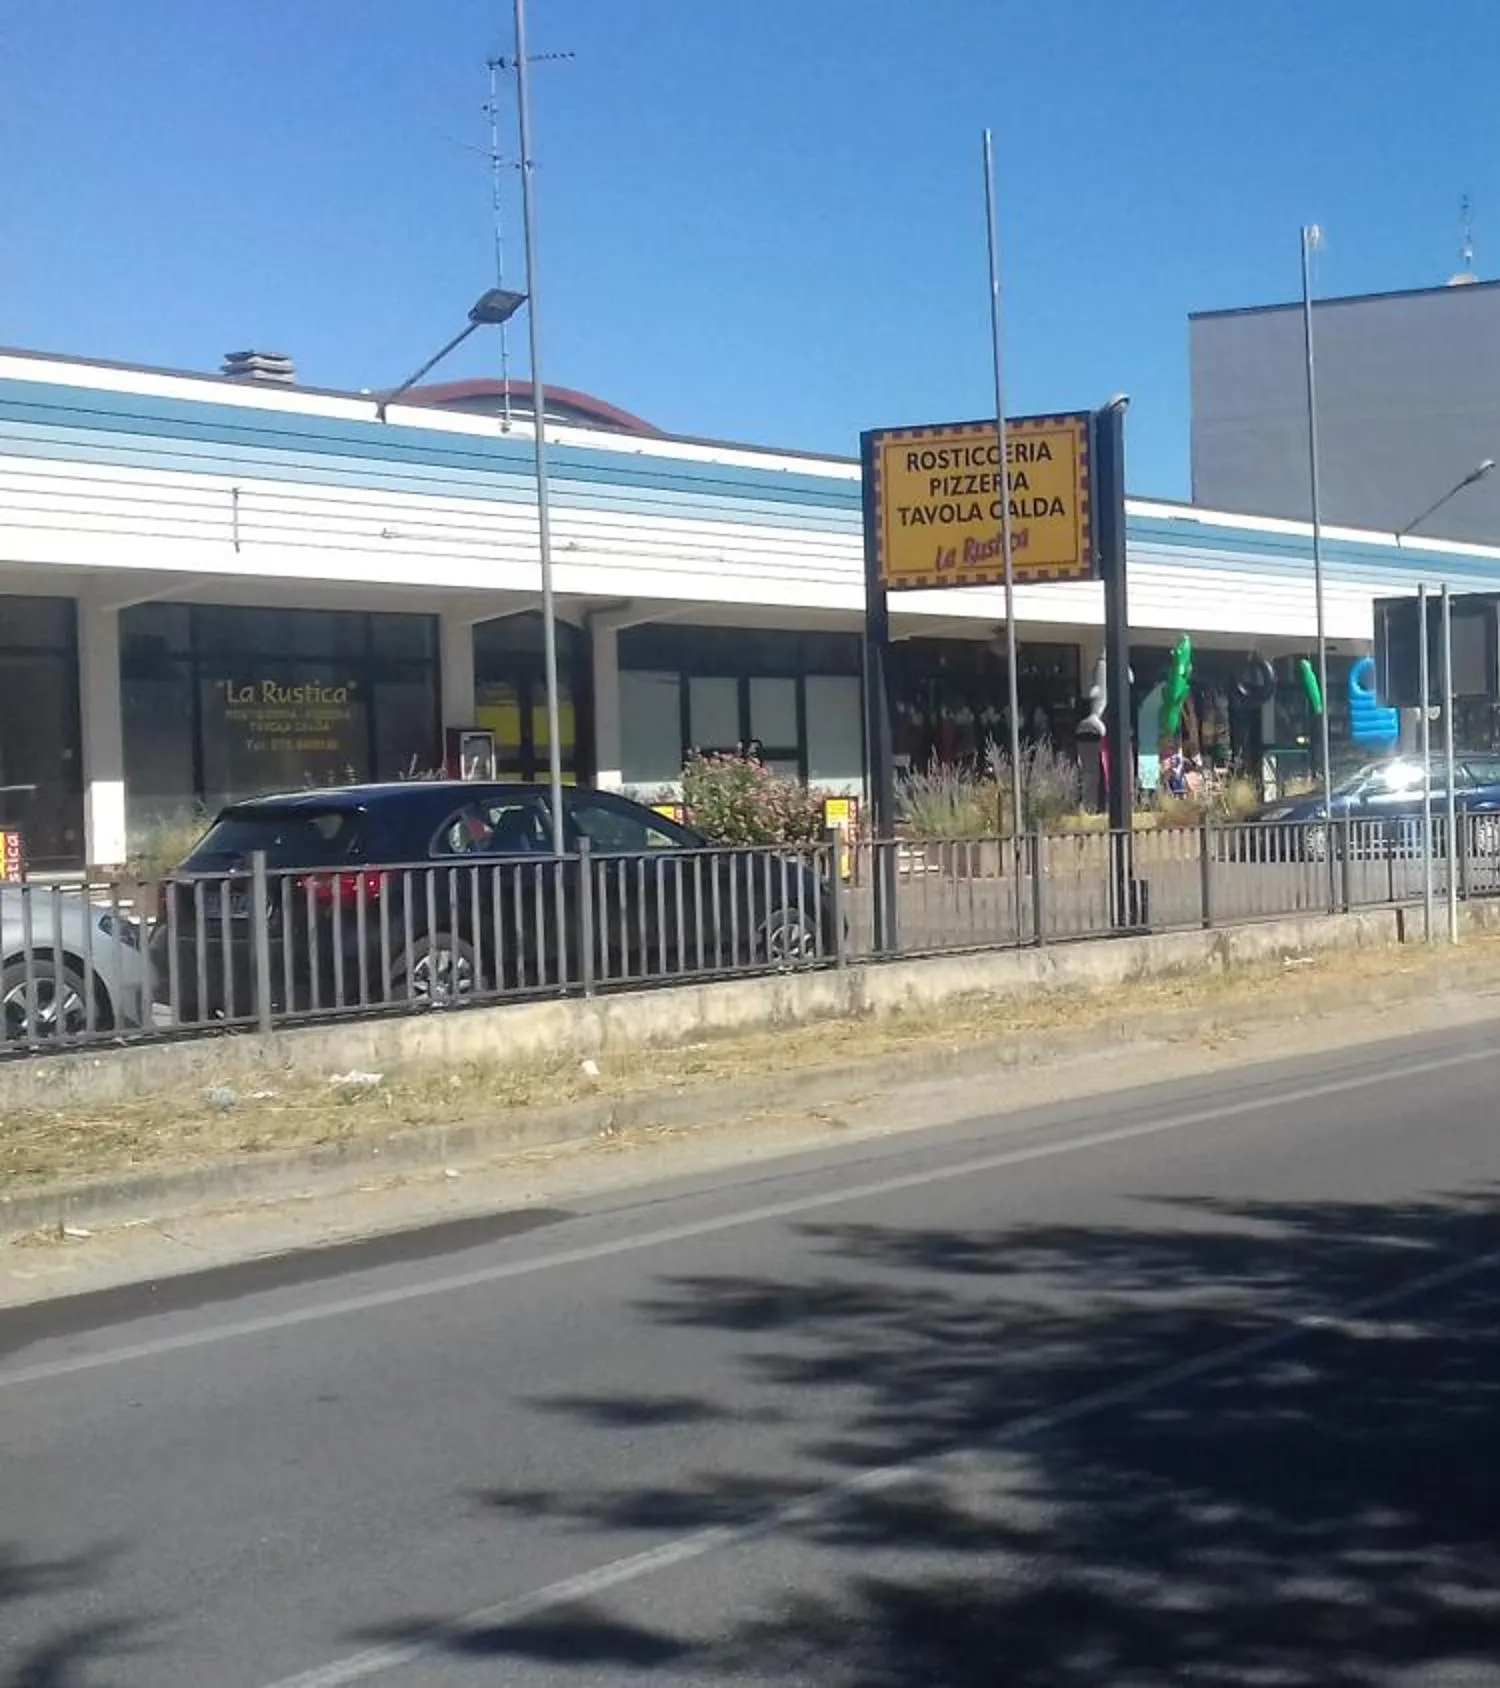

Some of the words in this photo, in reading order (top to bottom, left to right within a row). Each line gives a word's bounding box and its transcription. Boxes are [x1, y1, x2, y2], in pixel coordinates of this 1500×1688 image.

[907, 441, 1053, 472] ROSTICCERIA
[929, 472, 1029, 497] PIZZERIA
[897, 503, 983, 526] TAVOLA
[989, 497, 1065, 519] CALDA
[963, 528, 1029, 563] Rustca
